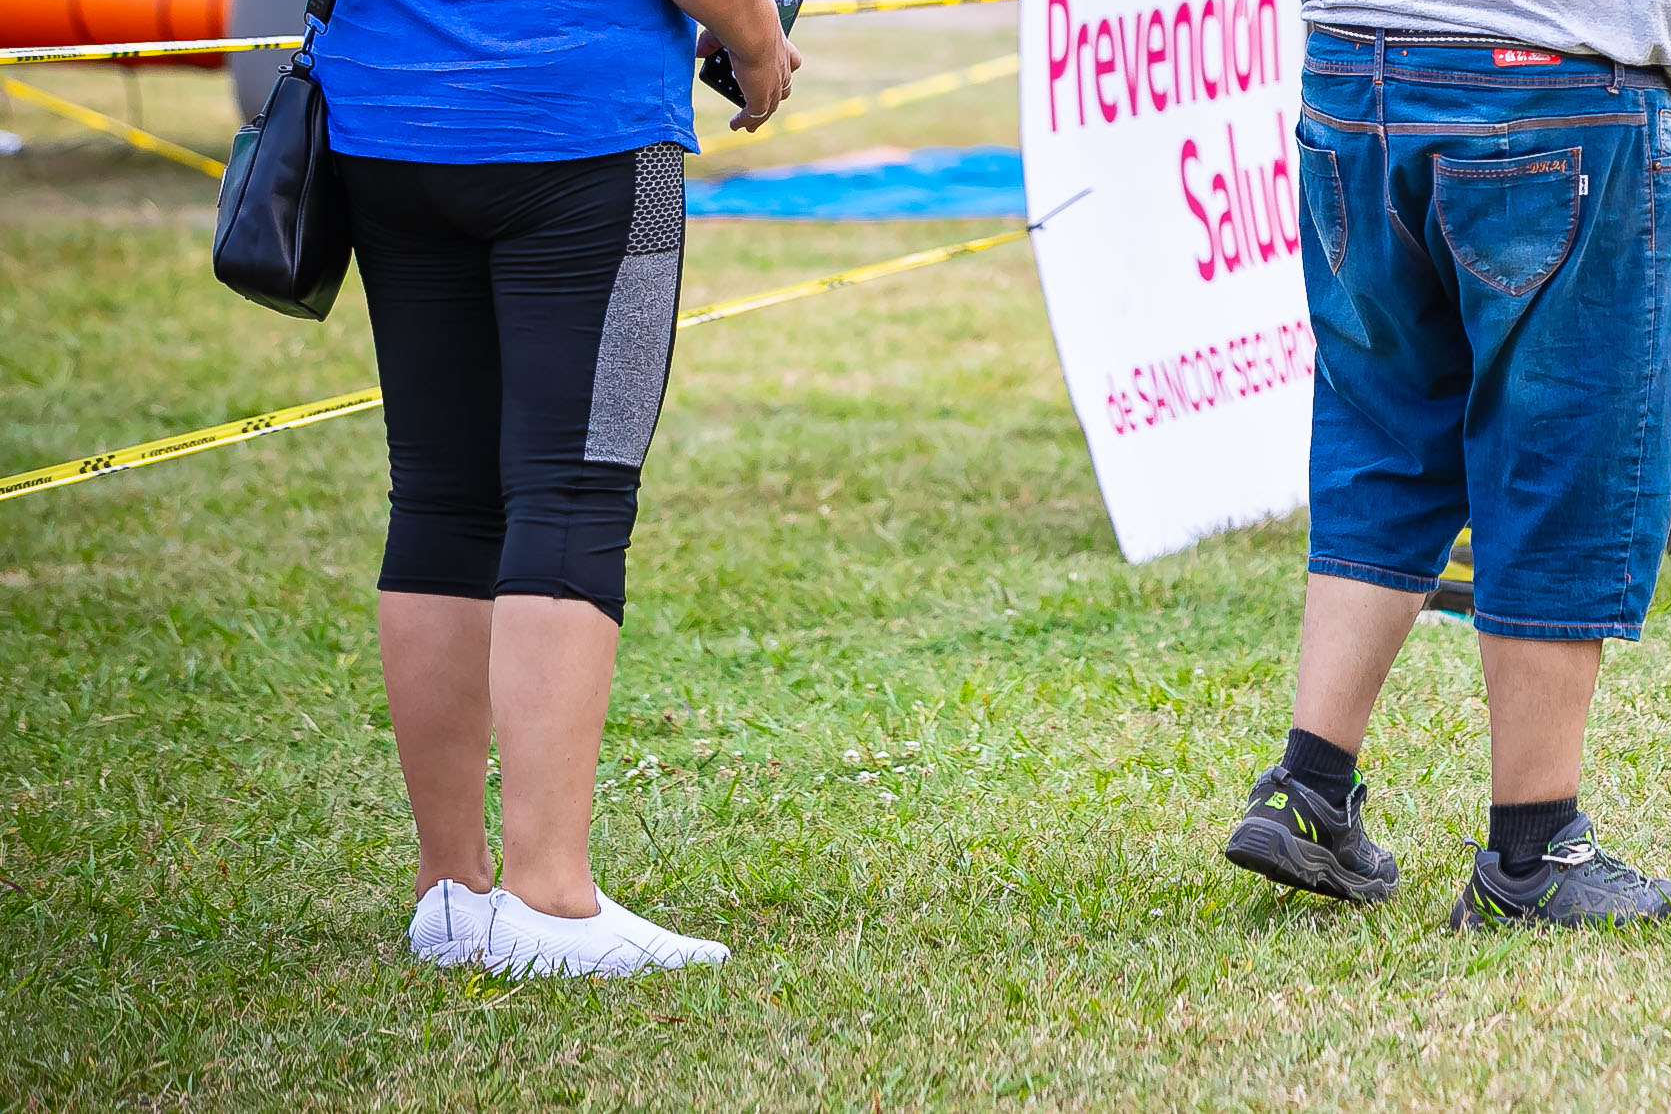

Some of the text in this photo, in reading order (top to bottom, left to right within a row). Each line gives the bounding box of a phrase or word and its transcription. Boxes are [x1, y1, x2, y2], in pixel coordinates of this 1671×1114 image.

[1180, 111, 1300, 282] Salud
[1105, 370, 1138, 436] de
[1132, 344, 1234, 426] SANCOR
